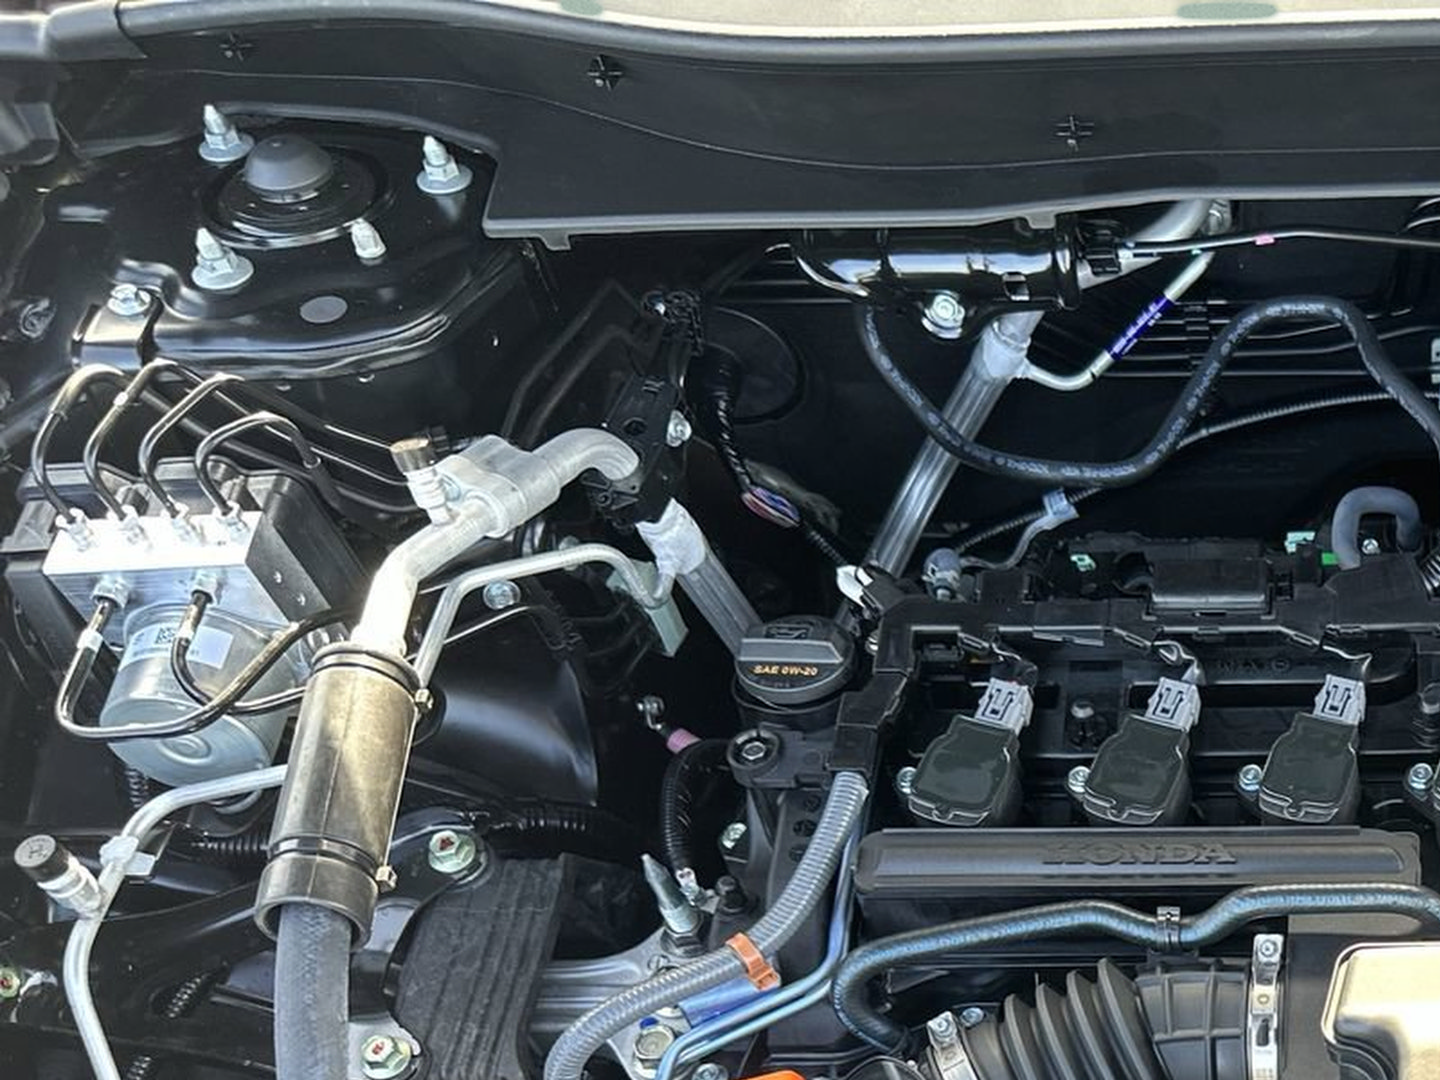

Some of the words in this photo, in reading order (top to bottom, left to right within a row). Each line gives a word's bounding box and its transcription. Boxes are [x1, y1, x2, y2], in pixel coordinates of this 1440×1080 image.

[752, 665, 779, 675] SAE
[781, 665, 818, 676] 0W-20
[1042, 841, 1238, 866] HONDA
